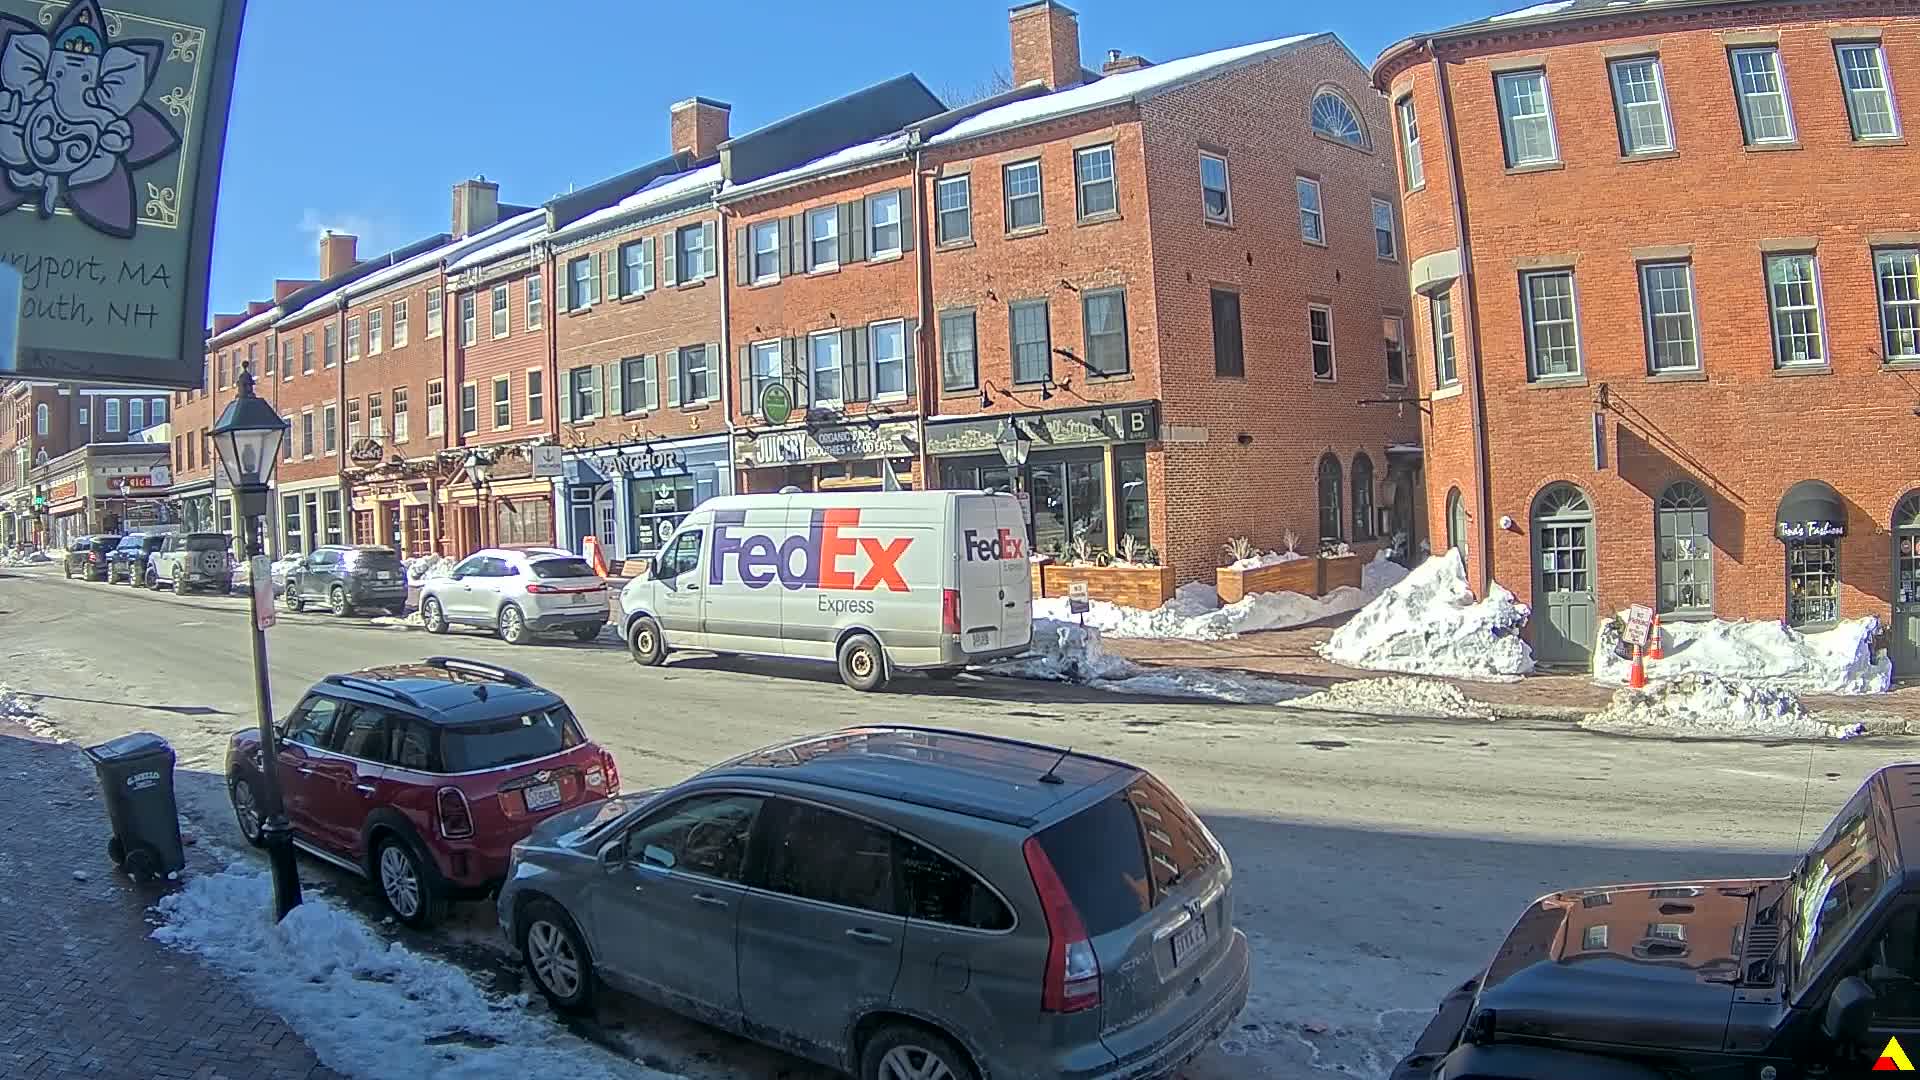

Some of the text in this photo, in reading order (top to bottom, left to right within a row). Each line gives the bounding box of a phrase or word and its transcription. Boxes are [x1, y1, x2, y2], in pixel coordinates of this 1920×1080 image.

[118, 260, 171, 289] MA
[23, 292, 159, 329] outh, NH
[1131, 412, 1145, 432] B
[608, 450, 676, 472] ANCHOR
[756, 433, 807, 463] JUICERY
[709, 508, 914, 592] FedEx
[964, 528, 1024, 561] FedEx
[818, 595, 874, 616] Express
